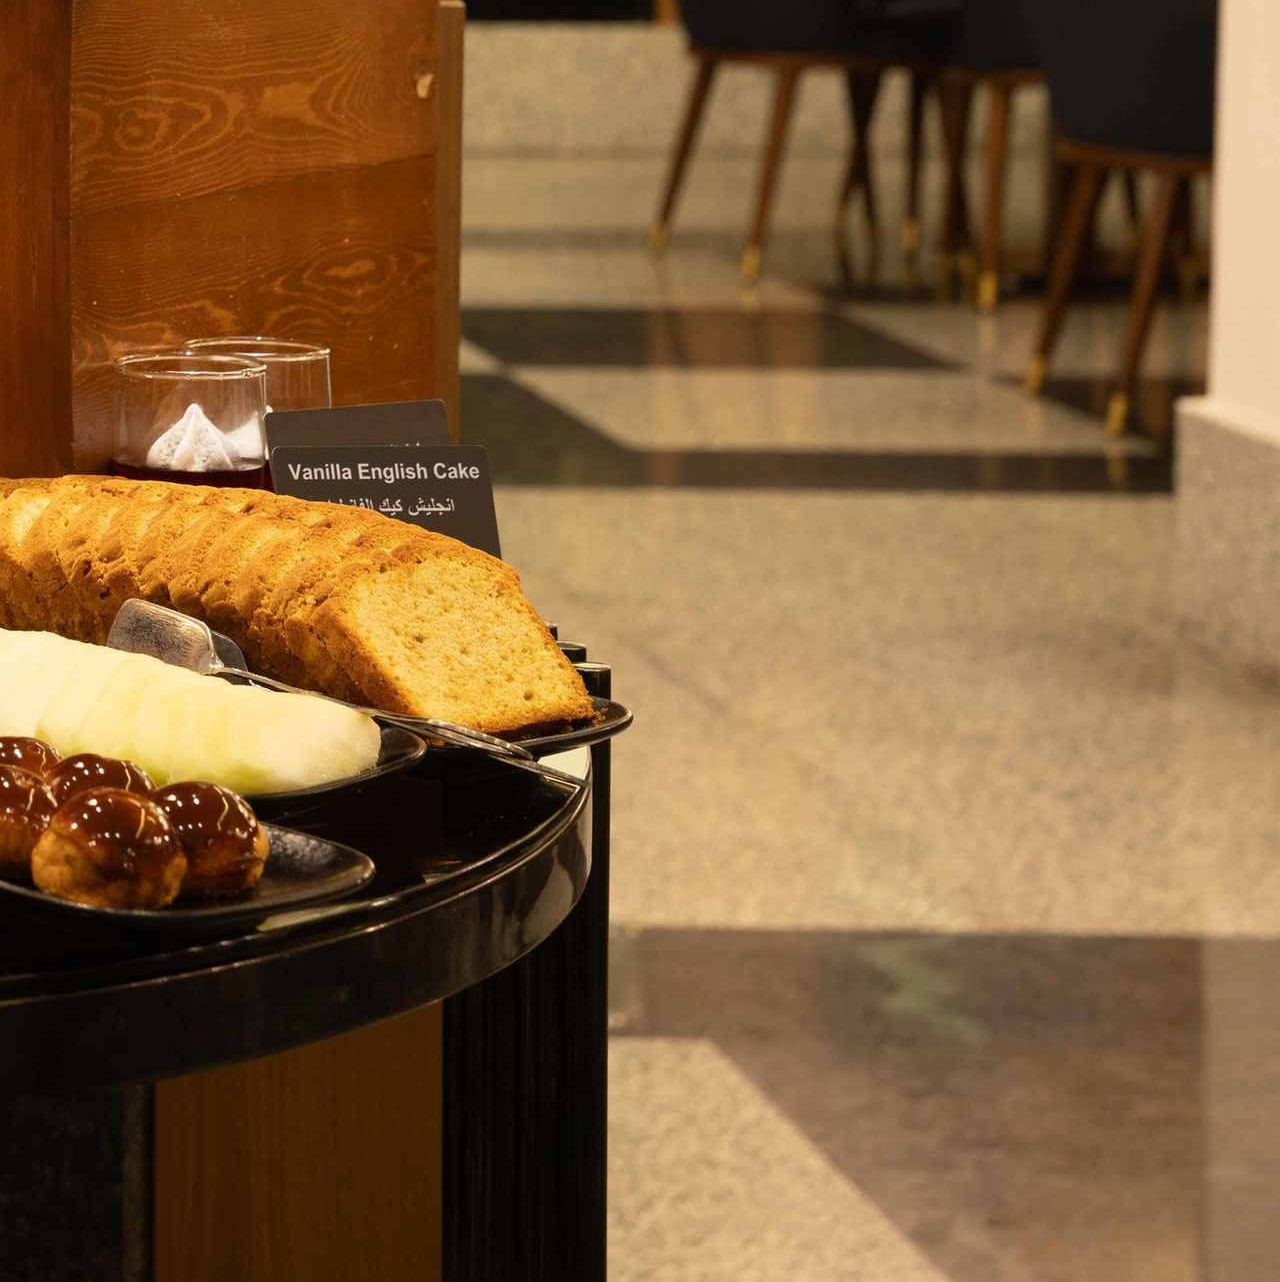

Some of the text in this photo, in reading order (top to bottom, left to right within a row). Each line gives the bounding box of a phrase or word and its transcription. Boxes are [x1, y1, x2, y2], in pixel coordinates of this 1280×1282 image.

[288, 462, 480, 484] Vanilla English Cake
[378, 498, 403, 515] كيك
[408, 497, 455, 516] انجليش
